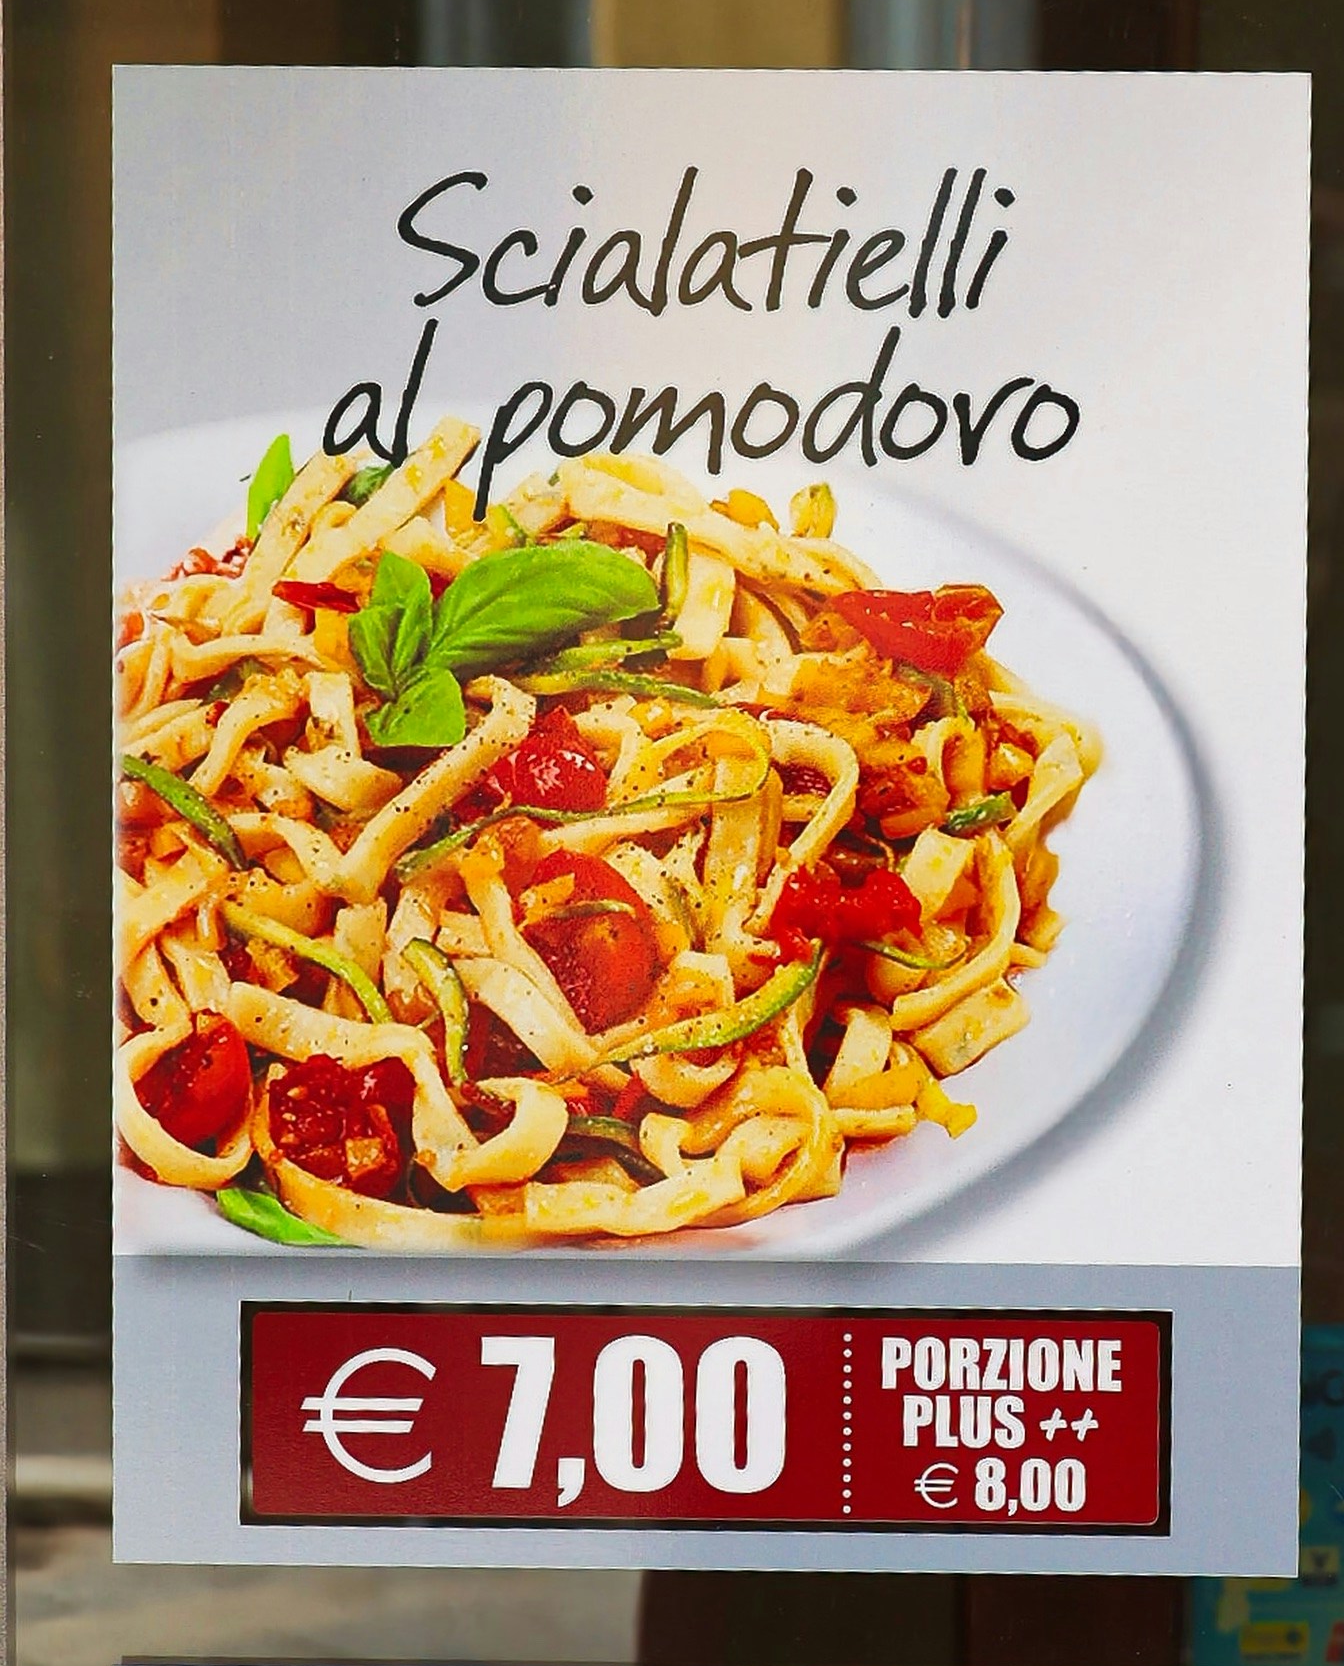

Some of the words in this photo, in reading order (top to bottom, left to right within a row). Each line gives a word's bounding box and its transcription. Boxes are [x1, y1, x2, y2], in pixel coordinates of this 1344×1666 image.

[398, 167, 1015, 318] Scialatielli
[323, 319, 438, 471] al
[474, 327, 1079, 521] pomodoro
[882, 1337, 1121, 1391] PORZIONE
[301, 1348, 436, 1483] €
[481, 1336, 786, 1507] 7,00
[903, 1395, 1025, 1448] PLUS
[1040, 1409, 1098, 1441] ++
[914, 1463, 958, 1508] €
[975, 1458, 1085, 1516] 8,00
